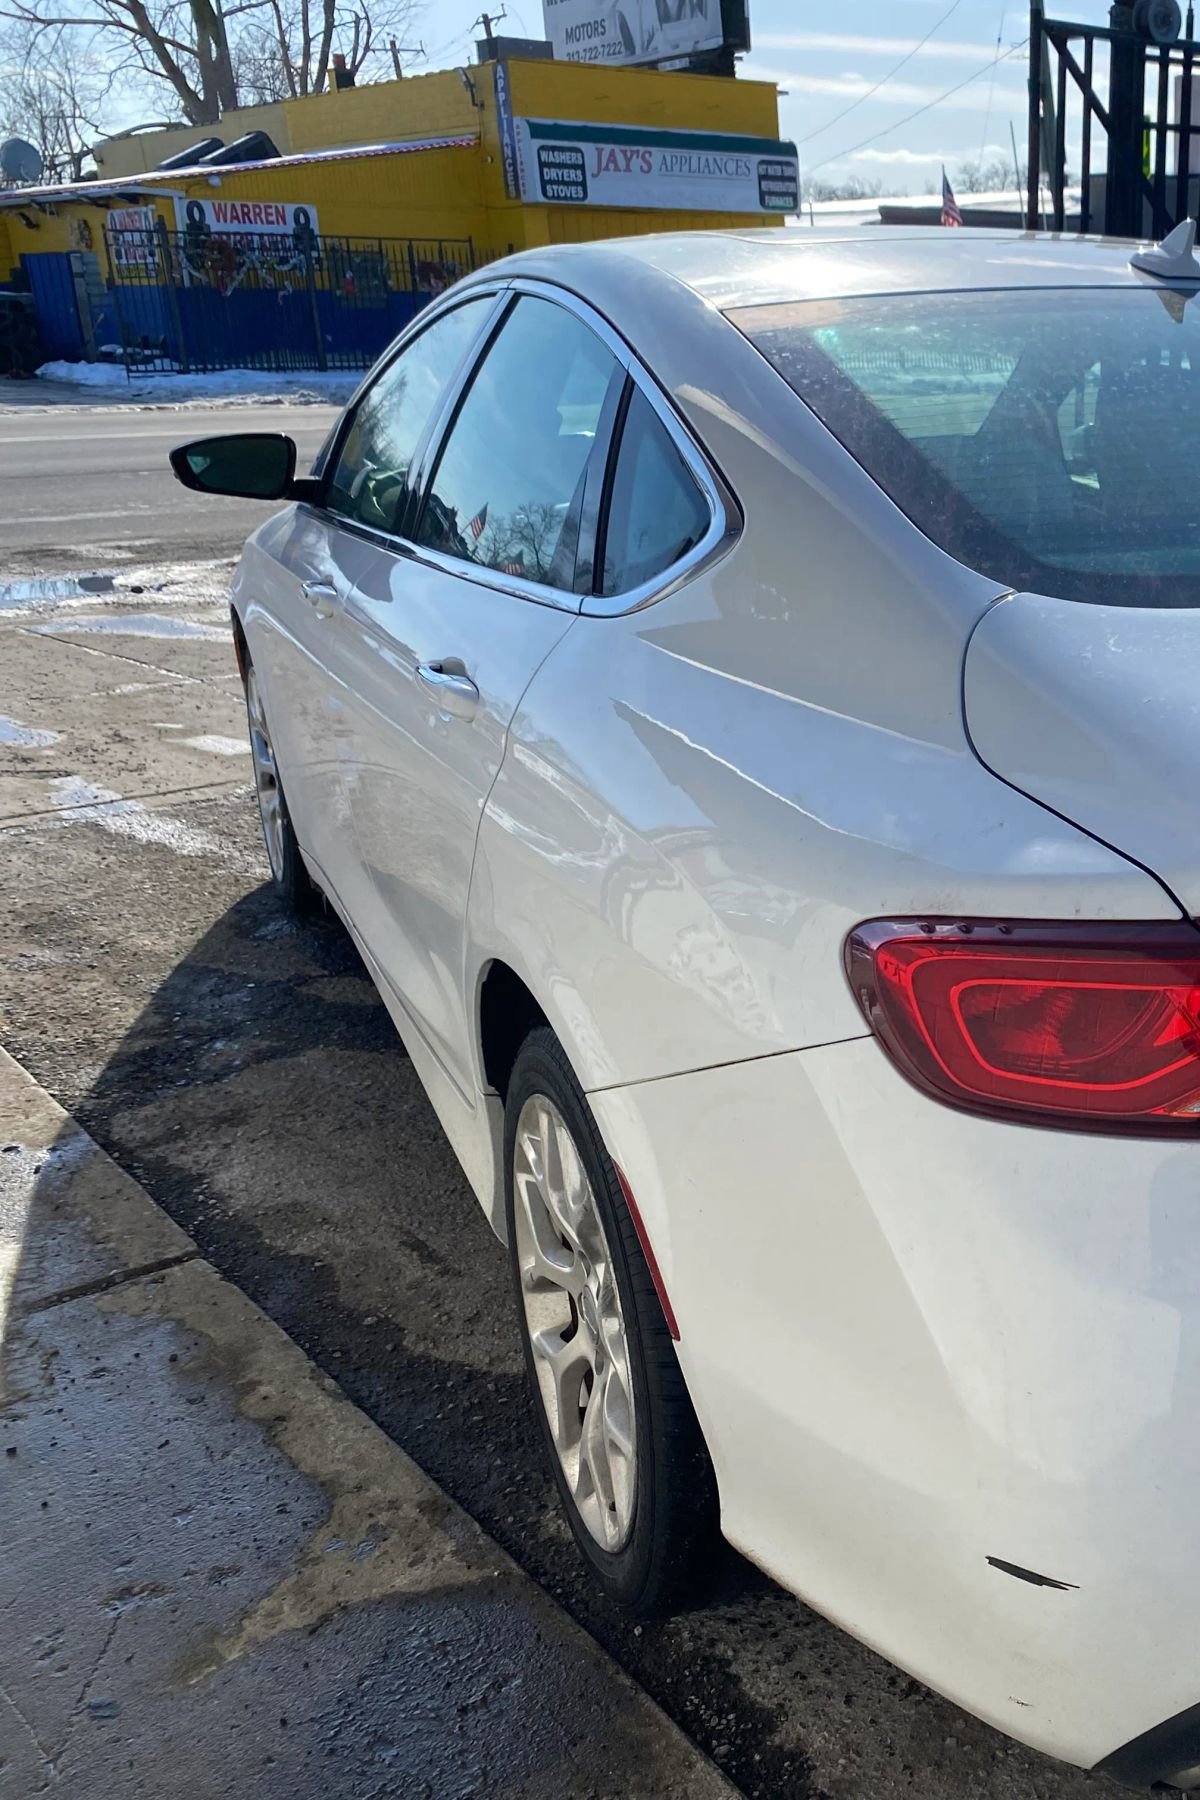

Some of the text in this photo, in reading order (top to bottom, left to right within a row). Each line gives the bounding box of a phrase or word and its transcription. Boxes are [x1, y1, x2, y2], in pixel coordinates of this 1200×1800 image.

[565, 18, 607, 45] MOTORS
[496, 64, 516, 198] APPLIANCES
[539, 149, 583, 165] WASHERS
[592, 146, 653, 178] JAY'S
[659, 153, 750, 177] APPLIANCES
[543, 167, 583, 182] DRYERS
[545, 184, 584, 199] STOVES
[212, 202, 287, 226] WARREN
